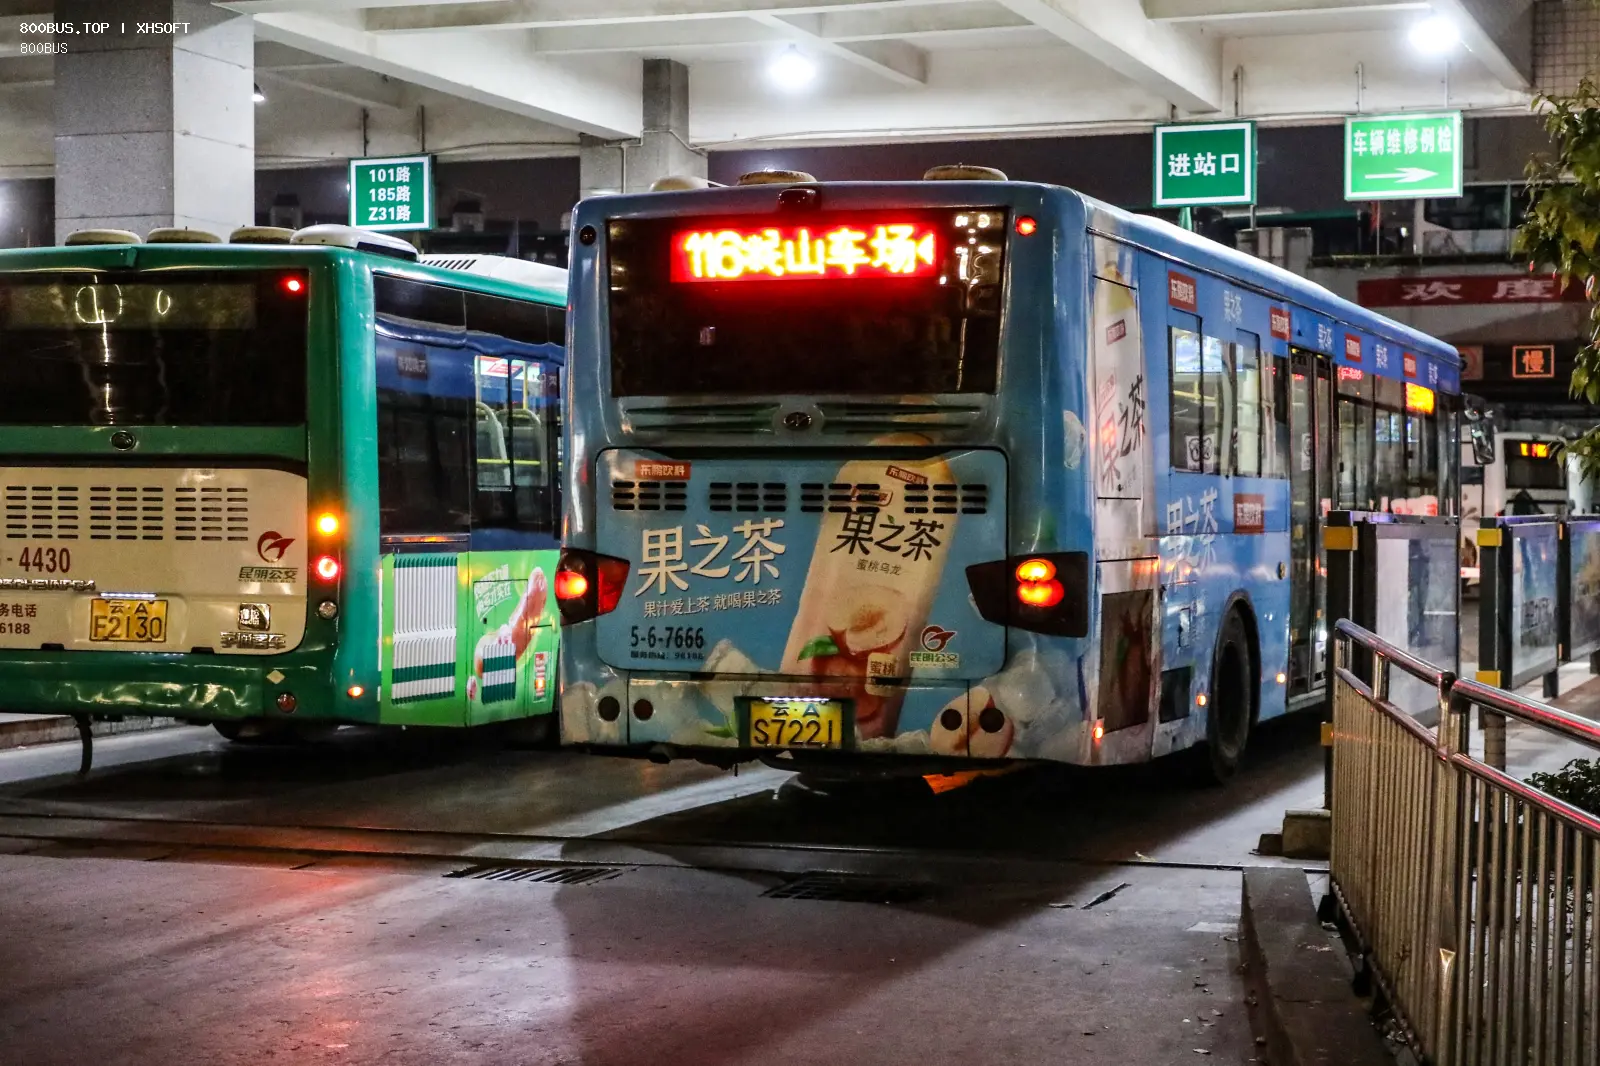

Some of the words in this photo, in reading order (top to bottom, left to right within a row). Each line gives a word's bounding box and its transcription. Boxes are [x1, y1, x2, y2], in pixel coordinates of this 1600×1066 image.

[1352, 125, 1453, 156] 车辆维修例检
[368, 165, 411, 183] 101路
[1168, 152, 1241, 177] 进站口
[368, 184, 412, 202] 185路
[367, 204, 412, 222] Z31路
[640, 464, 685, 477] 东鹏饮料
[830, 510, 945, 562] 果之茶
[634, 517, 786, 598] 果之茶
[856, 558, 902, 577] 蜜桃乌龙
[238, 566, 299, 580] 昆明公交
[643, 597, 711, 618] 果汁爱上茶
[713, 588, 783, 611] 就喝果之茶
[94, 615, 163, 640] F2130
[630, 625, 704, 648] 5-6-7666
[753, 718, 834, 745] S7221
